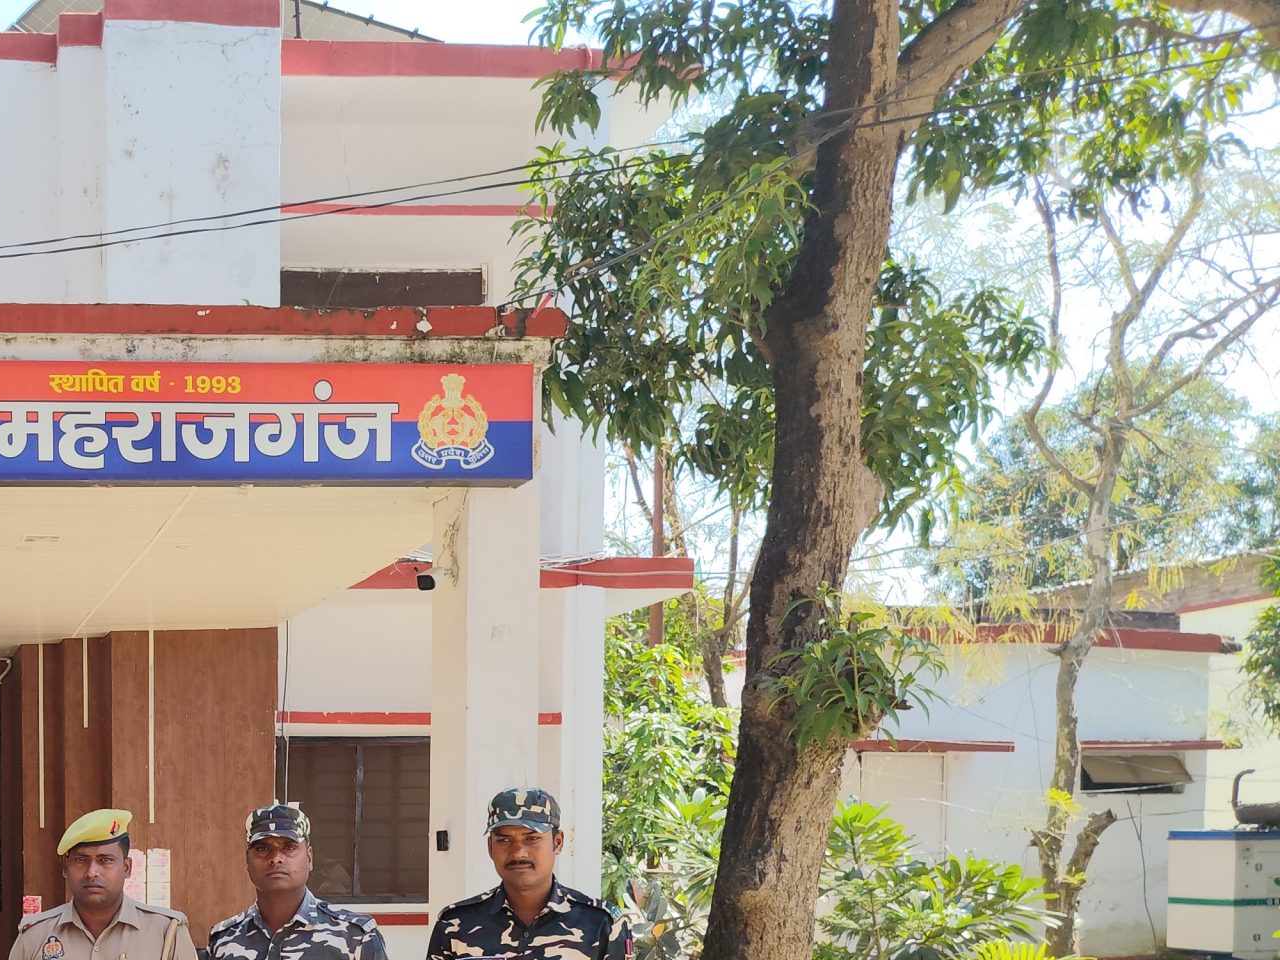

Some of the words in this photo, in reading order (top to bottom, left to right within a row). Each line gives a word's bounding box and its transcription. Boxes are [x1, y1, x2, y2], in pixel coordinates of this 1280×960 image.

[49, 368, 125, 393] स्थापित
[130, 370, 161, 393] वर्ष
[184, 375, 241, 394] 1993
